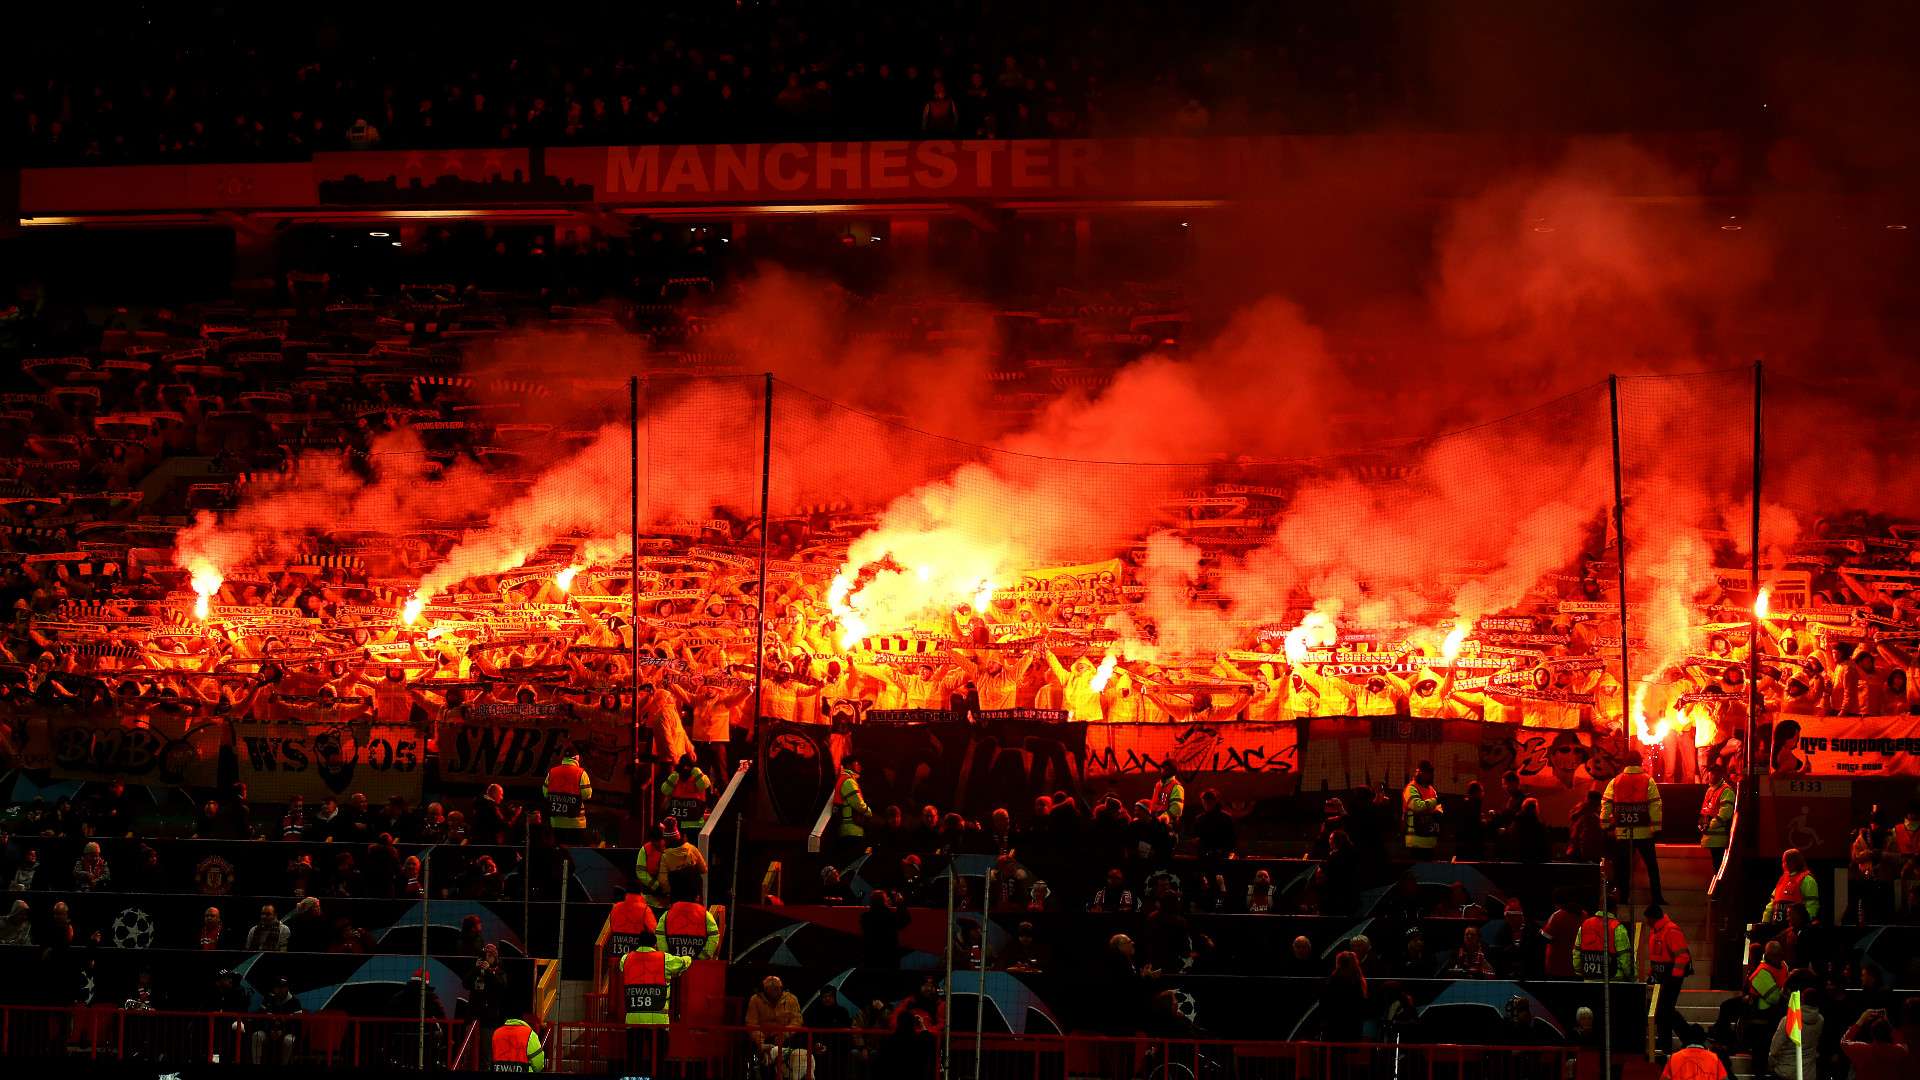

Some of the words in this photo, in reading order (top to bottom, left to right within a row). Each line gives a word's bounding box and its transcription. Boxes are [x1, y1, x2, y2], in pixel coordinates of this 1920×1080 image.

[605, 139, 1105, 193] MANCHESTER
[683, 638, 723, 646] YOUNG
[242, 736, 309, 771] WS
[1790, 780, 1823, 792] E133
[551, 802, 568, 813] 520
[671, 807, 689, 817] 515
[1619, 813, 1640, 823] 363
[674, 945, 696, 957] 184
[1583, 962, 1602, 974] 091
[630, 996, 652, 1008] 158
